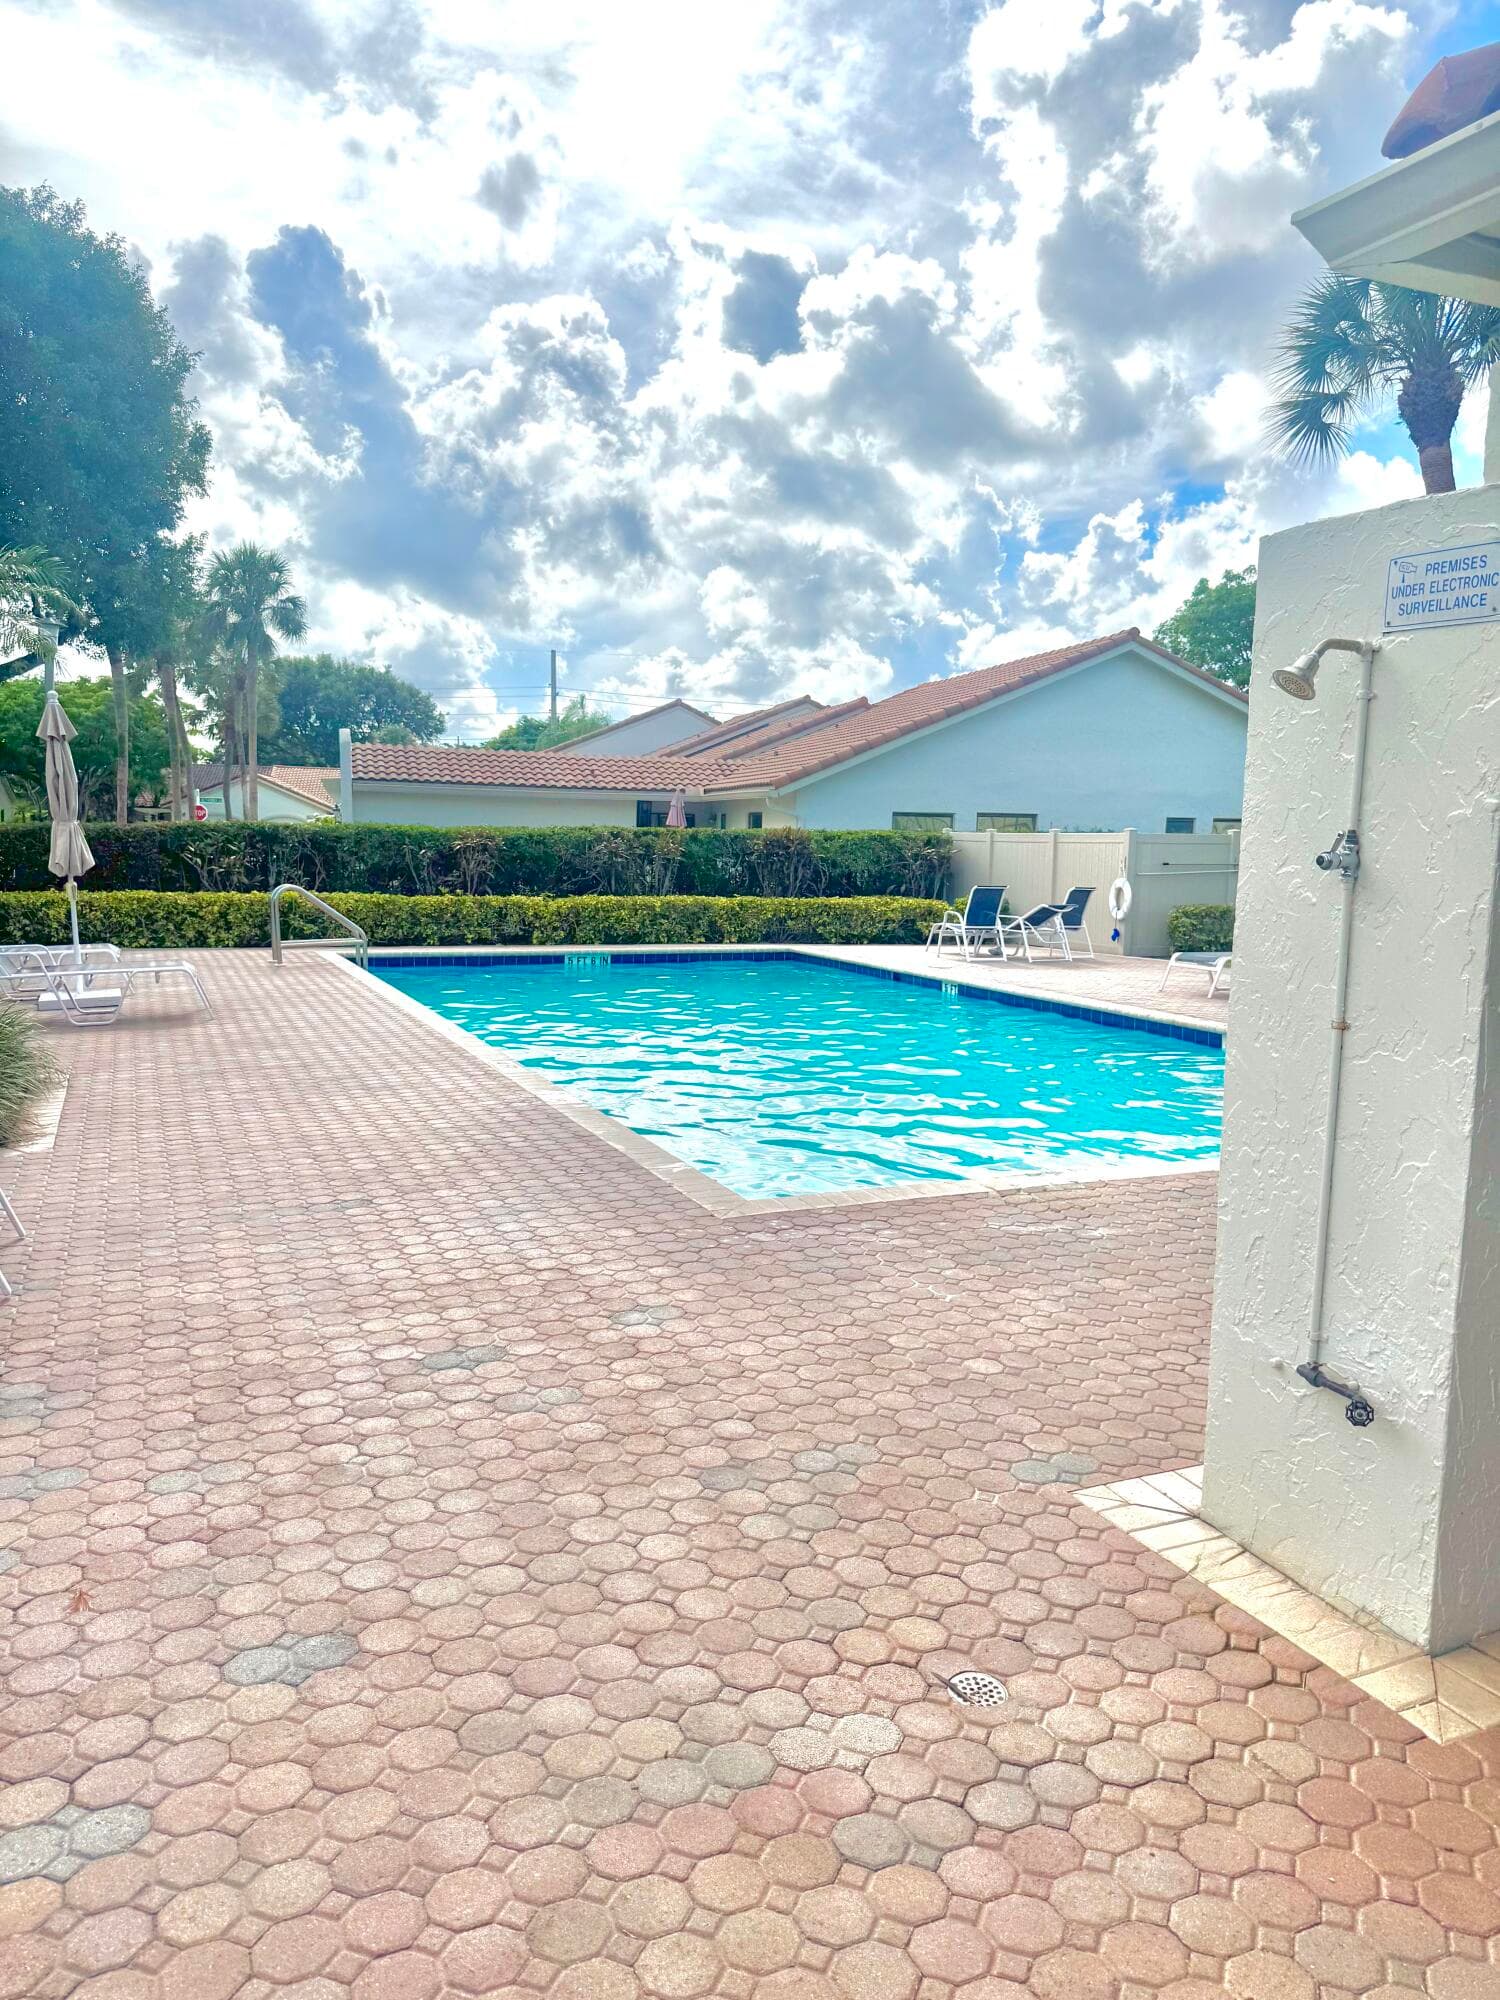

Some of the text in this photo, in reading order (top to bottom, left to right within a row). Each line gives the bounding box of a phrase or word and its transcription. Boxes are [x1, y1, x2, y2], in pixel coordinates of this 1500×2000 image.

[1425, 555, 1488, 576] PREMISES
[1391, 572, 1500, 599] UNDER ELECTRONIC
[1398, 593, 1488, 616] SURVEILLANCE
[567, 956, 573, 964] 5
[577, 956, 587, 965] FT
[599, 956, 609, 965] IN
